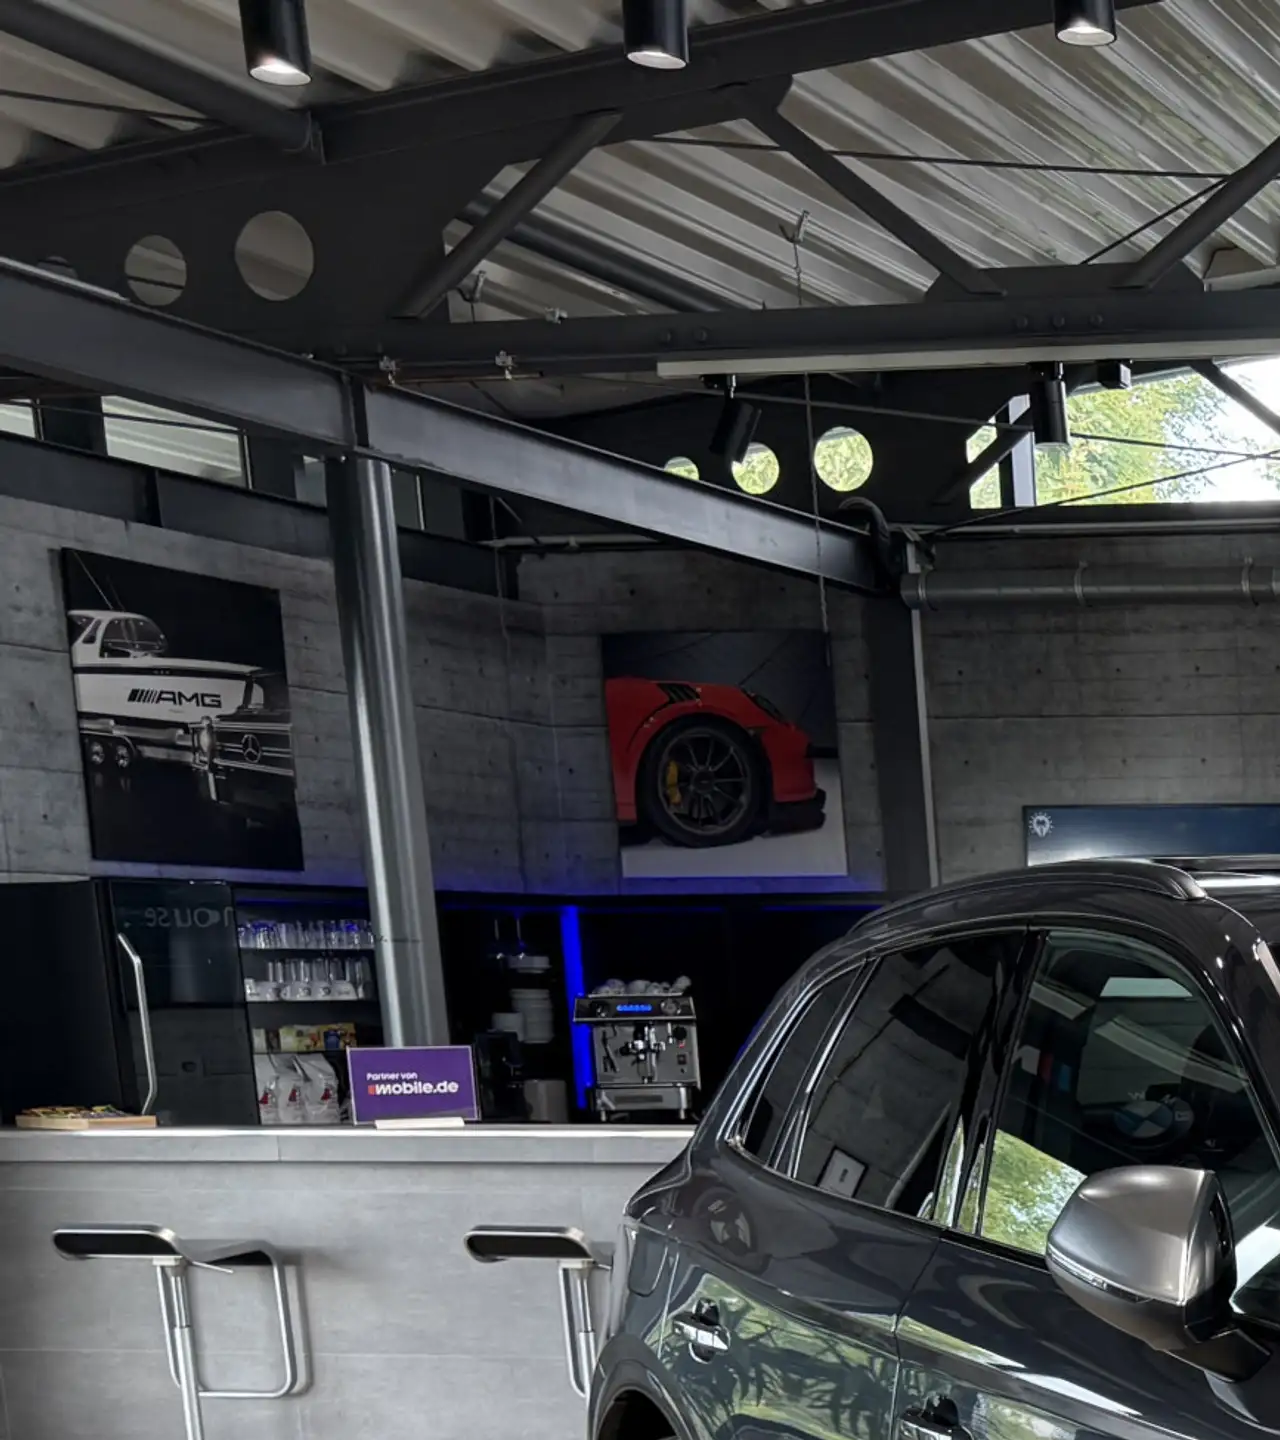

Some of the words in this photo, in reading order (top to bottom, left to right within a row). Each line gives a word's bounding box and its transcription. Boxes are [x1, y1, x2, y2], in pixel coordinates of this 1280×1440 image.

[157, 690, 222, 709] AMG
[366, 1072, 399, 1082] Partner
[401, 1071, 418, 1080] von
[375, 1080, 459, 1096] mobile.de
